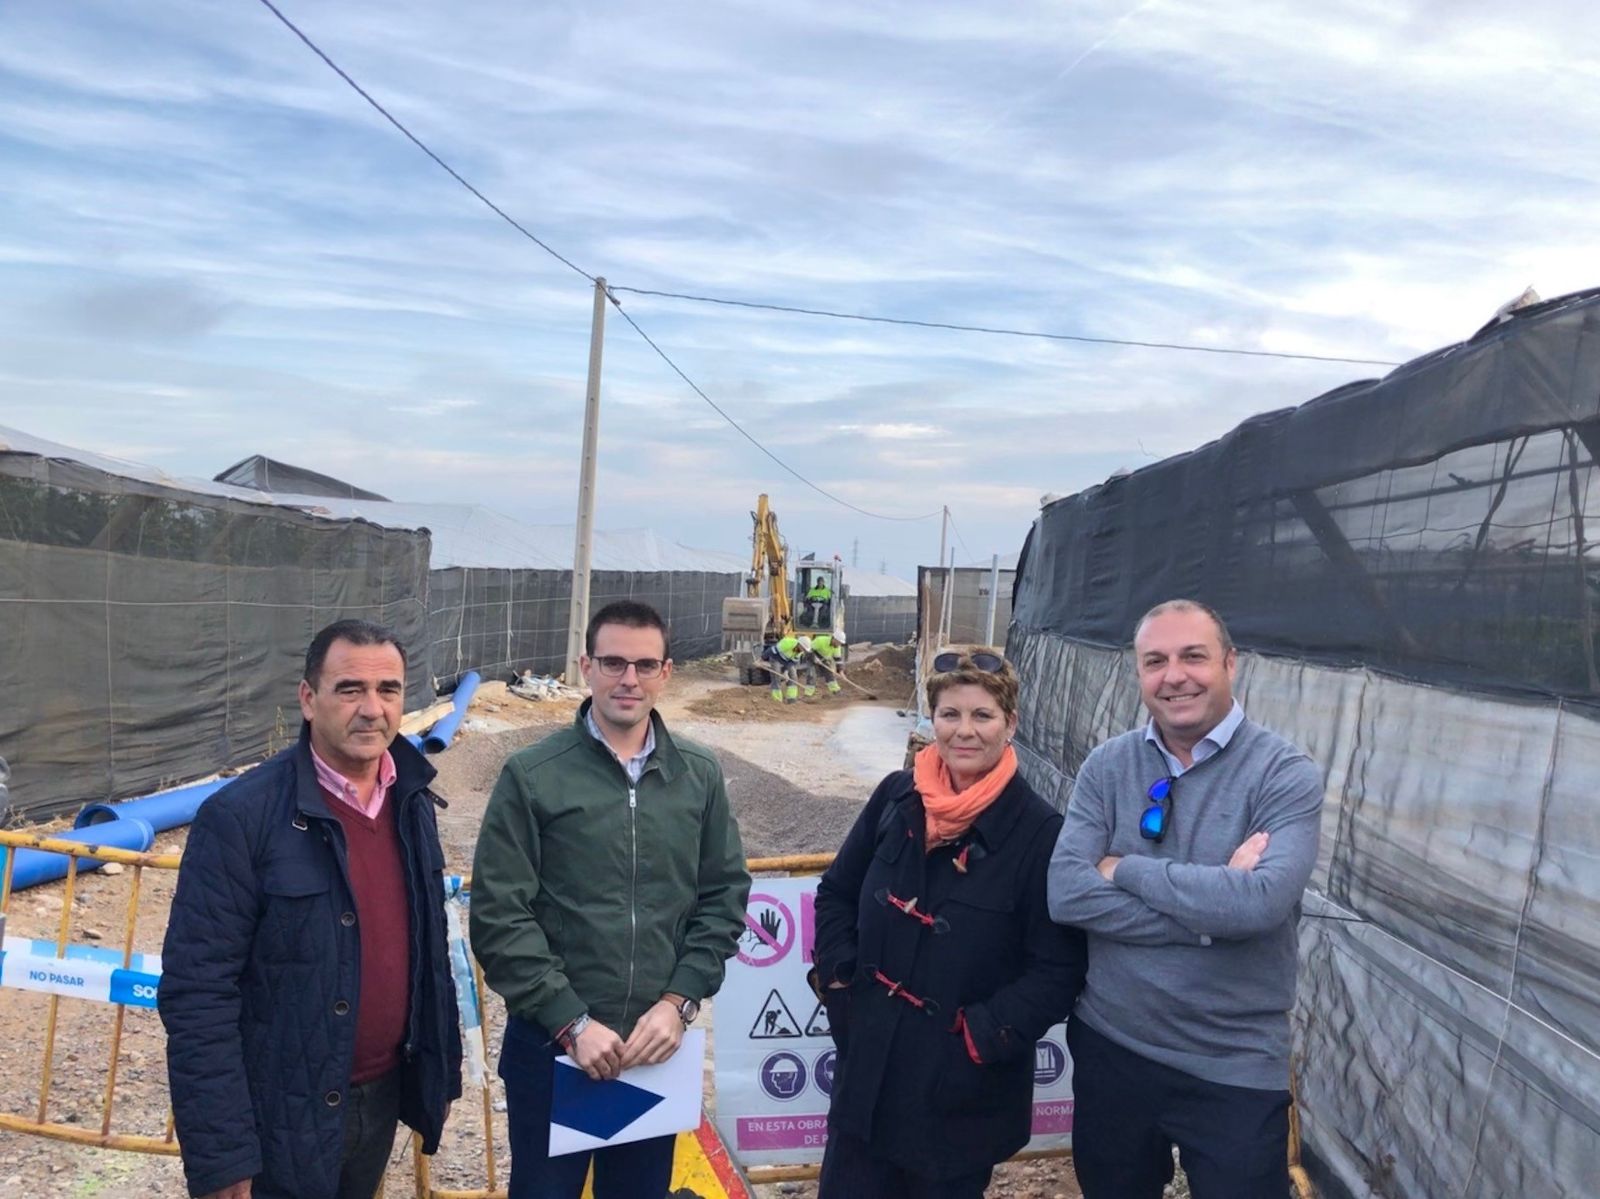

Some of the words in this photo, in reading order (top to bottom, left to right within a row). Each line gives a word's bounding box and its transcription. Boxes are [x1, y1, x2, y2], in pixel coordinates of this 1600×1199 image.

[29, 970, 47, 982] NO
[49, 972, 85, 987] PASAR
[132, 983, 158, 999] SO
[748, 1121, 764, 1132] EN
[766, 1120, 795, 1132] ESTA
[797, 1119, 828, 1130] OBRA
[804, 1134, 820, 1145] DE
